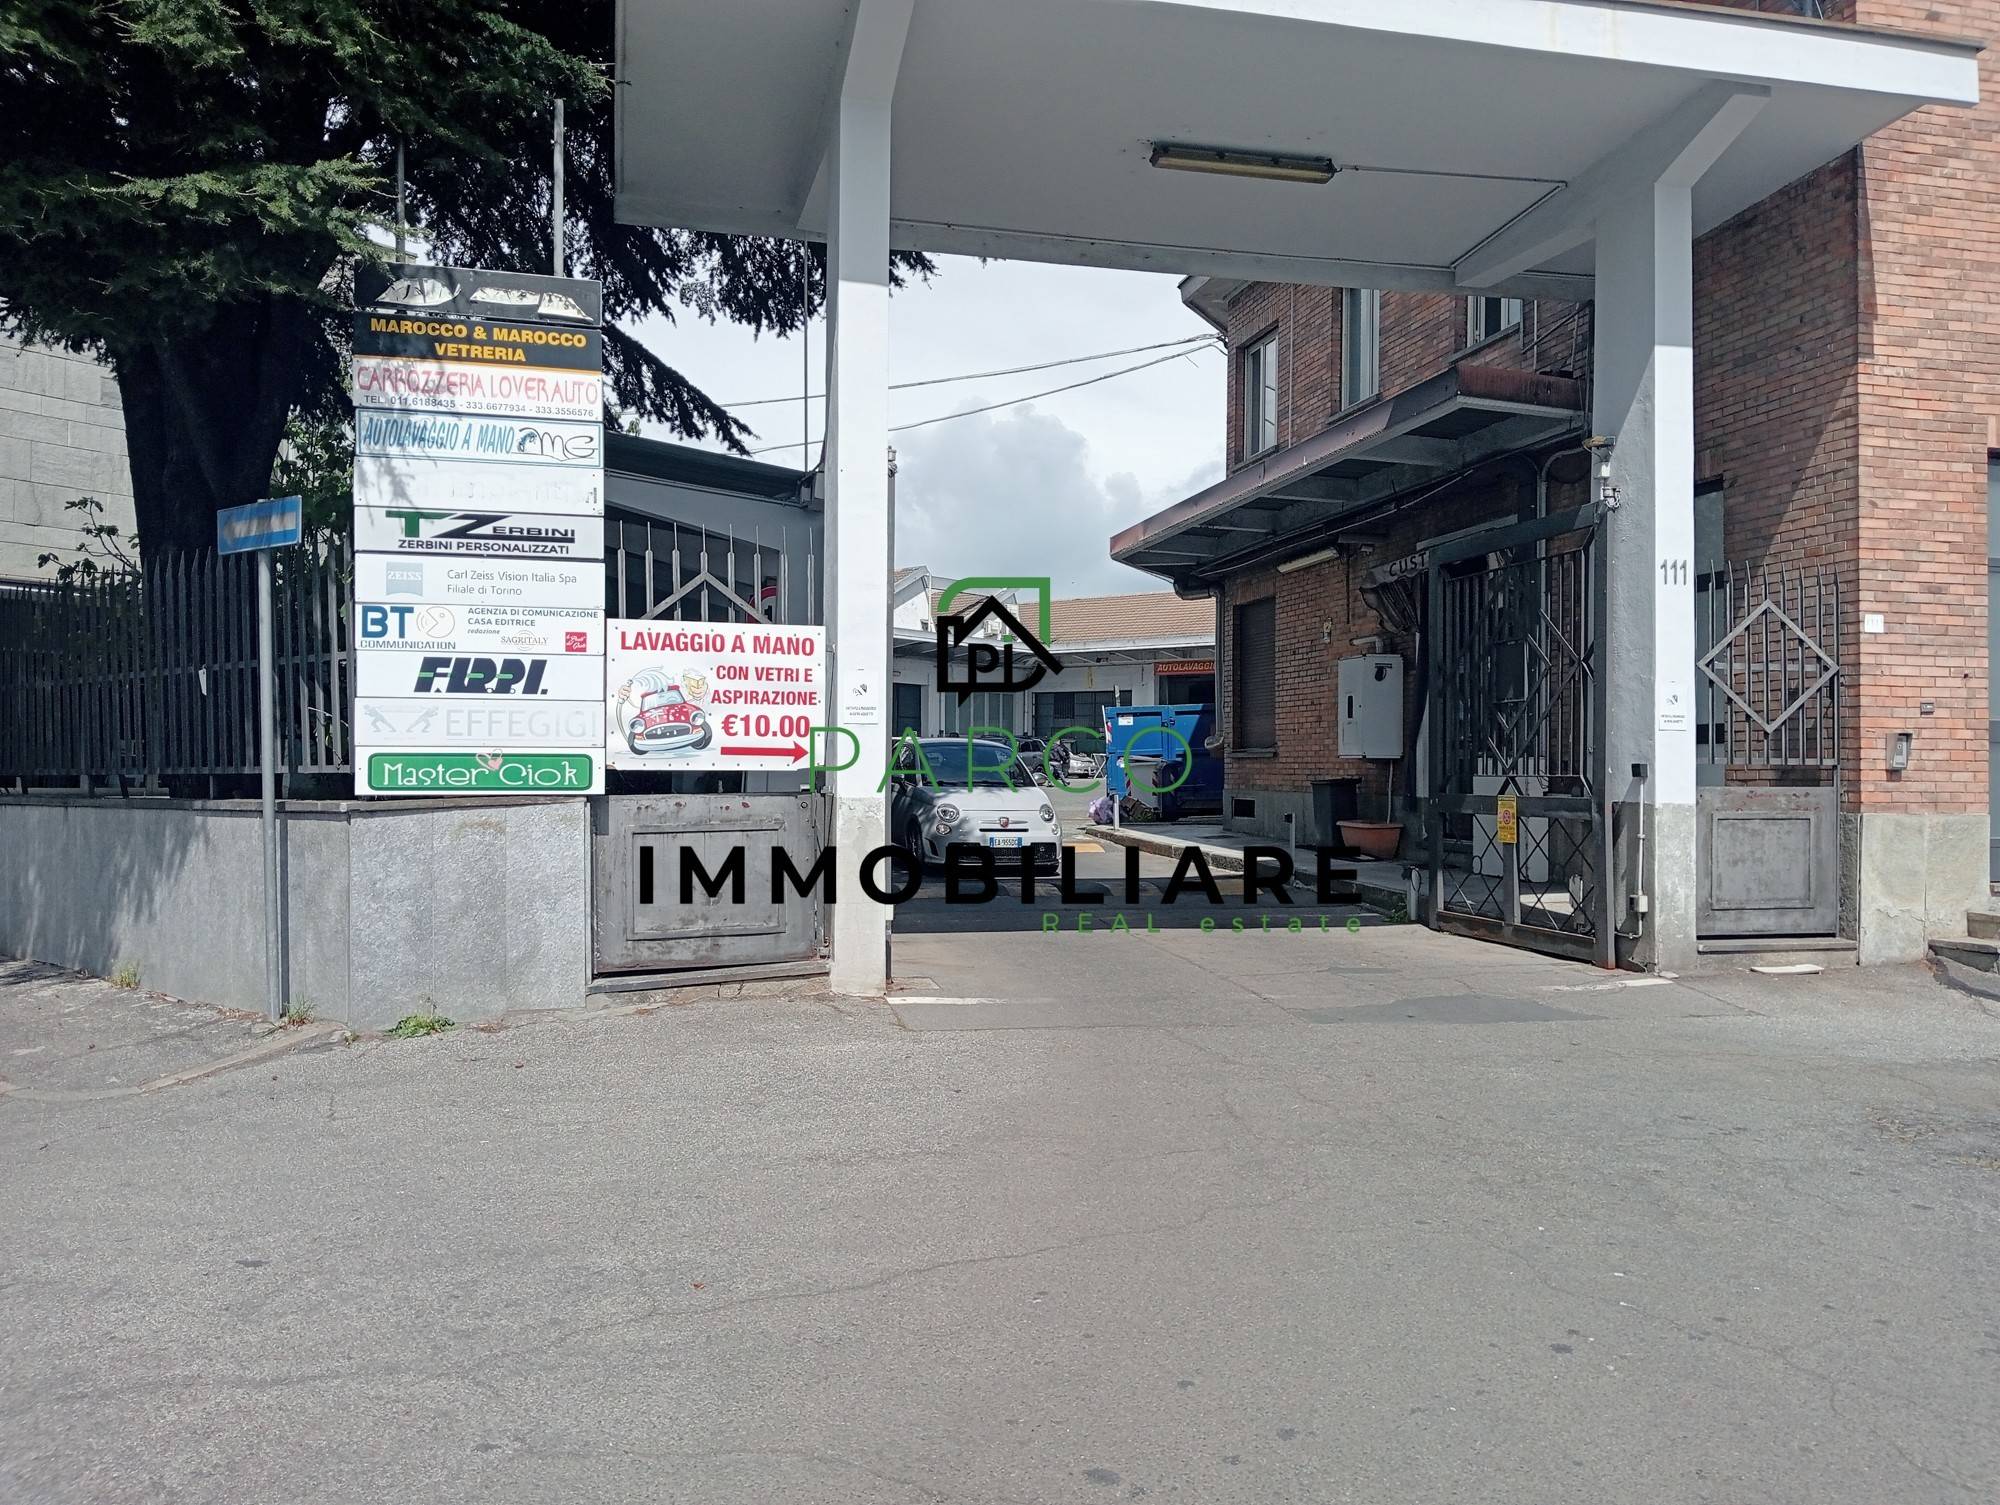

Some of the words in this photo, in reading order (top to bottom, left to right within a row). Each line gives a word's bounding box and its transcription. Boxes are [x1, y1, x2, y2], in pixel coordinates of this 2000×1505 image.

[371, 318, 467, 338] MAROCCO
[473, 326, 487, 340] &
[493, 327, 587, 347] MAROCCO
[434, 343, 526, 362] VETRERIA
[357, 366, 486, 398] CARROZZERIA
[390, 396, 456, 408] 011.6188435
[466, 401, 526, 412] 333.6677934
[535, 406, 594, 417] 333.3556576
[363, 417, 459, 450] AUTOLAVAGGIO
[461, 423, 473, 450] A
[476, 423, 515, 454] MANO
[398, 539, 455, 551] ZERBINI
[458, 541, 569, 555] PERSONALIZZATI
[387, 570, 422, 581] ZEISS
[447, 569, 468, 580] Carl
[470, 570, 495, 581] Zeiss
[498, 571, 529, 582] Vision
[531, 572, 556, 583] Italia
[558, 574, 577, 585] Spa
[1660, 559, 1687, 586] 111
[447, 584, 475, 595] Filiale
[478, 584, 488, 595] di
[490, 585, 522, 596] Torino
[361, 605, 415, 639] BT
[468, 607, 508, 616] AGENZIA
[510, 608, 520, 616] DI
[522, 609, 599, 619] COMUNICAZIONE
[468, 617, 493, 626] CASA
[495, 618, 536, 627] EDITRICE
[467, 627, 501, 635] redazione
[360, 640, 456, 650] COMMUNICATION
[620, 631, 725, 653] LAVAGGIO
[731, 634, 745, 653] A
[753, 636, 815, 656] MANO
[716, 665, 749, 681] CON
[754, 666, 800, 682] VETRI
[804, 668, 813, 683] E
[711, 689, 817, 706] ASPIRAZIONE
[446, 708, 597, 738] EFFEGIGI
[721, 714, 810, 738] €10.00
[383, 762, 489, 786] Master
[499, 760, 578, 786] Ciok
